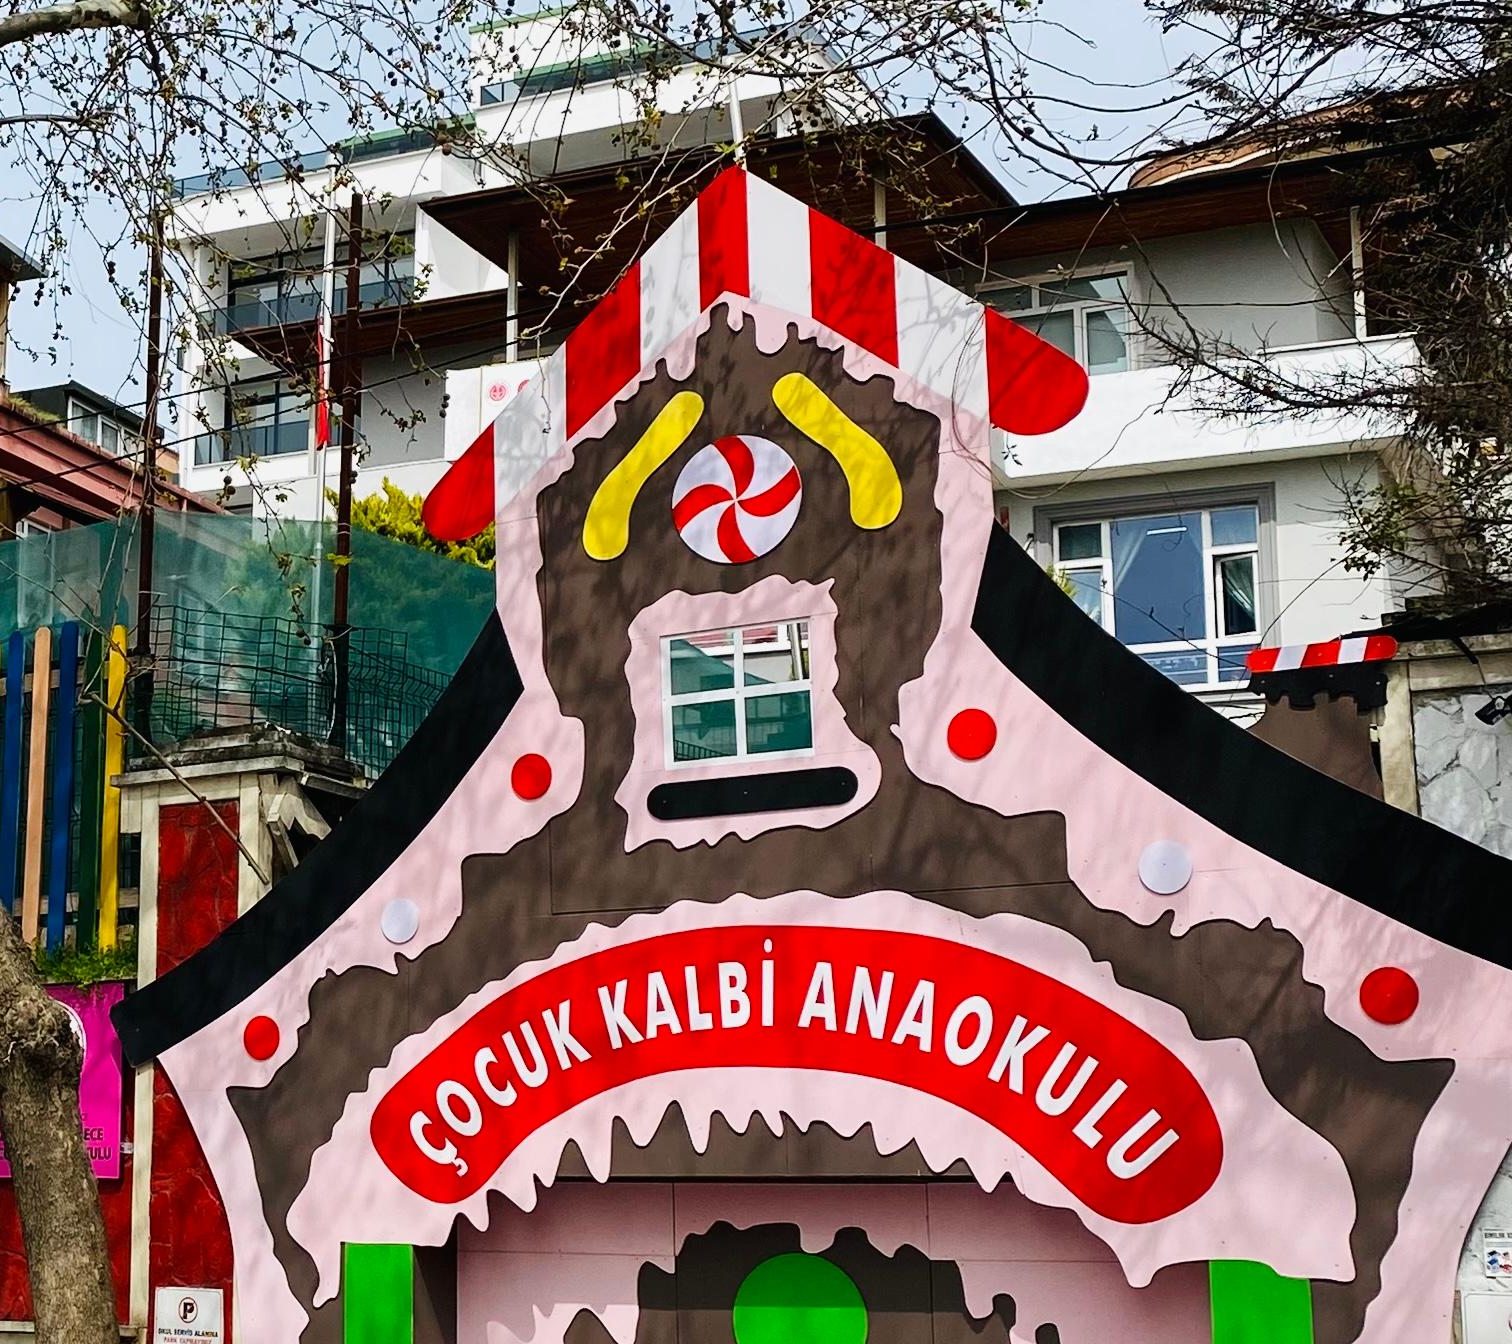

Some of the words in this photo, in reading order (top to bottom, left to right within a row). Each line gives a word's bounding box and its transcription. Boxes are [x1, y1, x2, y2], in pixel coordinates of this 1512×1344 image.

[409, 1000, 592, 1176] ÇOCUK
[598, 938, 775, 1050] KALBİ
[798, 961, 1180, 1180] ANAOKULU
[183, 1301, 195, 1319] P
